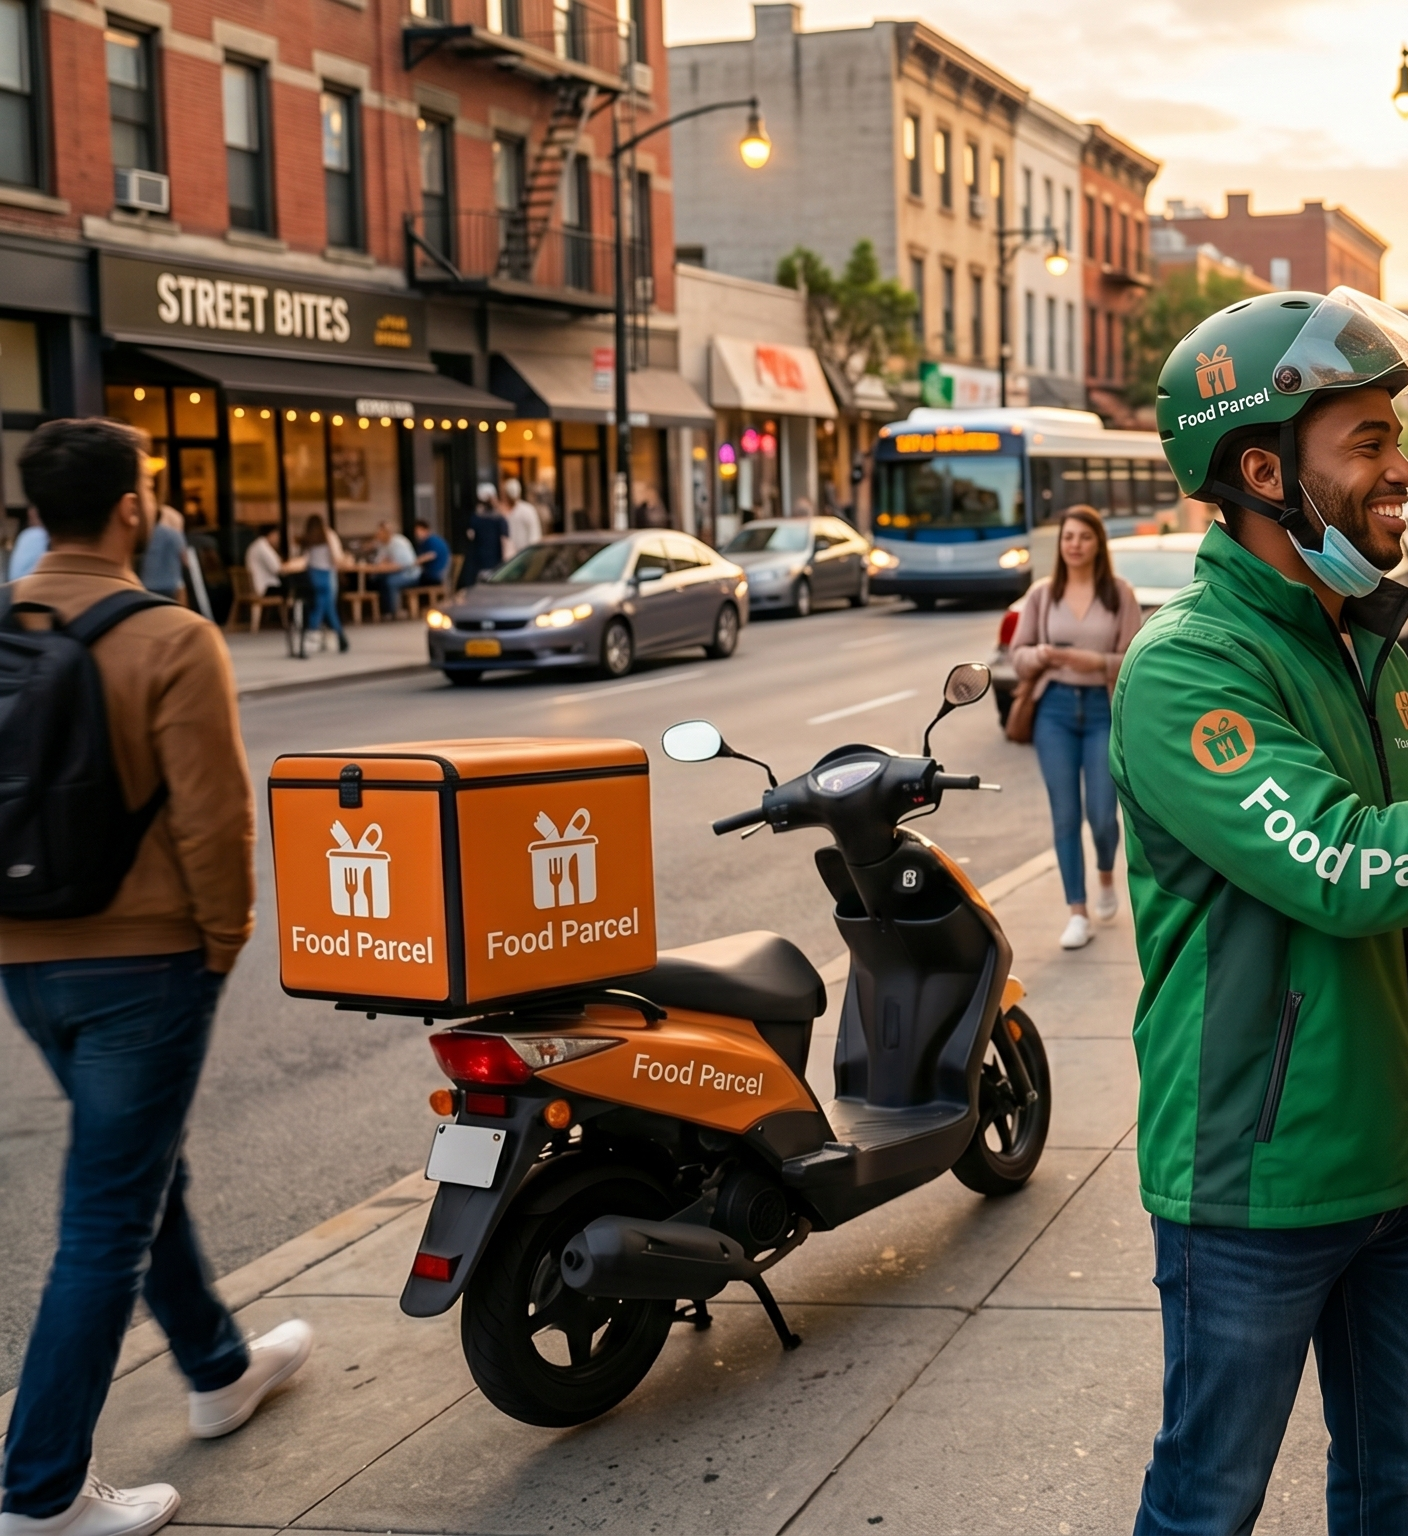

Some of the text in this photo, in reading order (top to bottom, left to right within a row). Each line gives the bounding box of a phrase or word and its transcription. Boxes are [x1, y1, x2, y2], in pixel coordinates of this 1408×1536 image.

[157, 272, 350, 343] STREET BITES
[1177, 388, 1270, 430] Food Parcel
[1239, 776, 1355, 885] Food
[292, 926, 433, 964] Food Parcel
[487, 907, 639, 959] Food Parcel
[632, 1053, 763, 1096] Food Parcel
